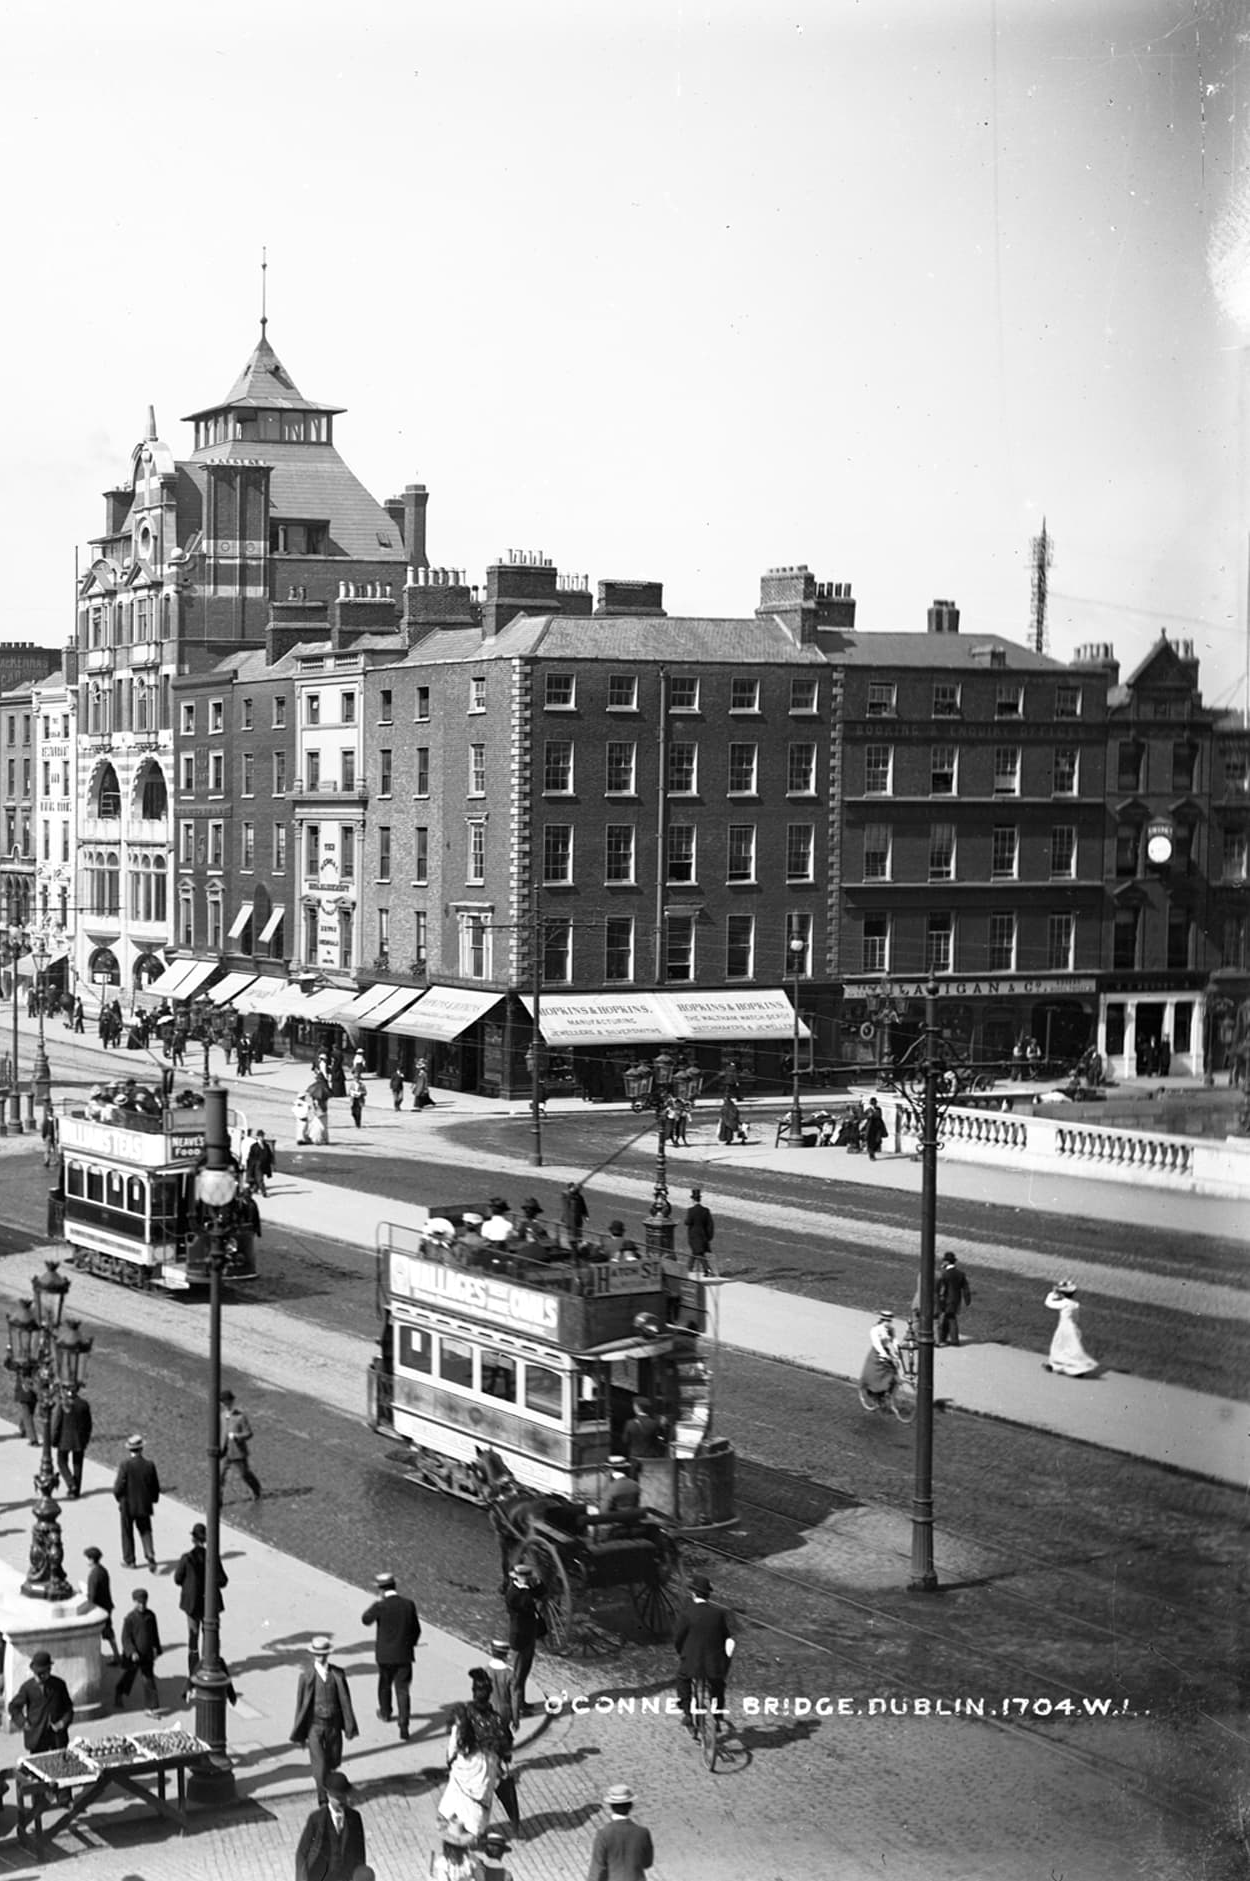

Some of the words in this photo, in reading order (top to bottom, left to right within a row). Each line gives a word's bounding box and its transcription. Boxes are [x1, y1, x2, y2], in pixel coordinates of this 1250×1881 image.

[1008, 983, 1016, 994] &
[540, 1007, 588, 1017] HOPKINS
[676, 1003, 727, 1012] HOPKINS
[172, 1135, 205, 1149] NEAVE'S
